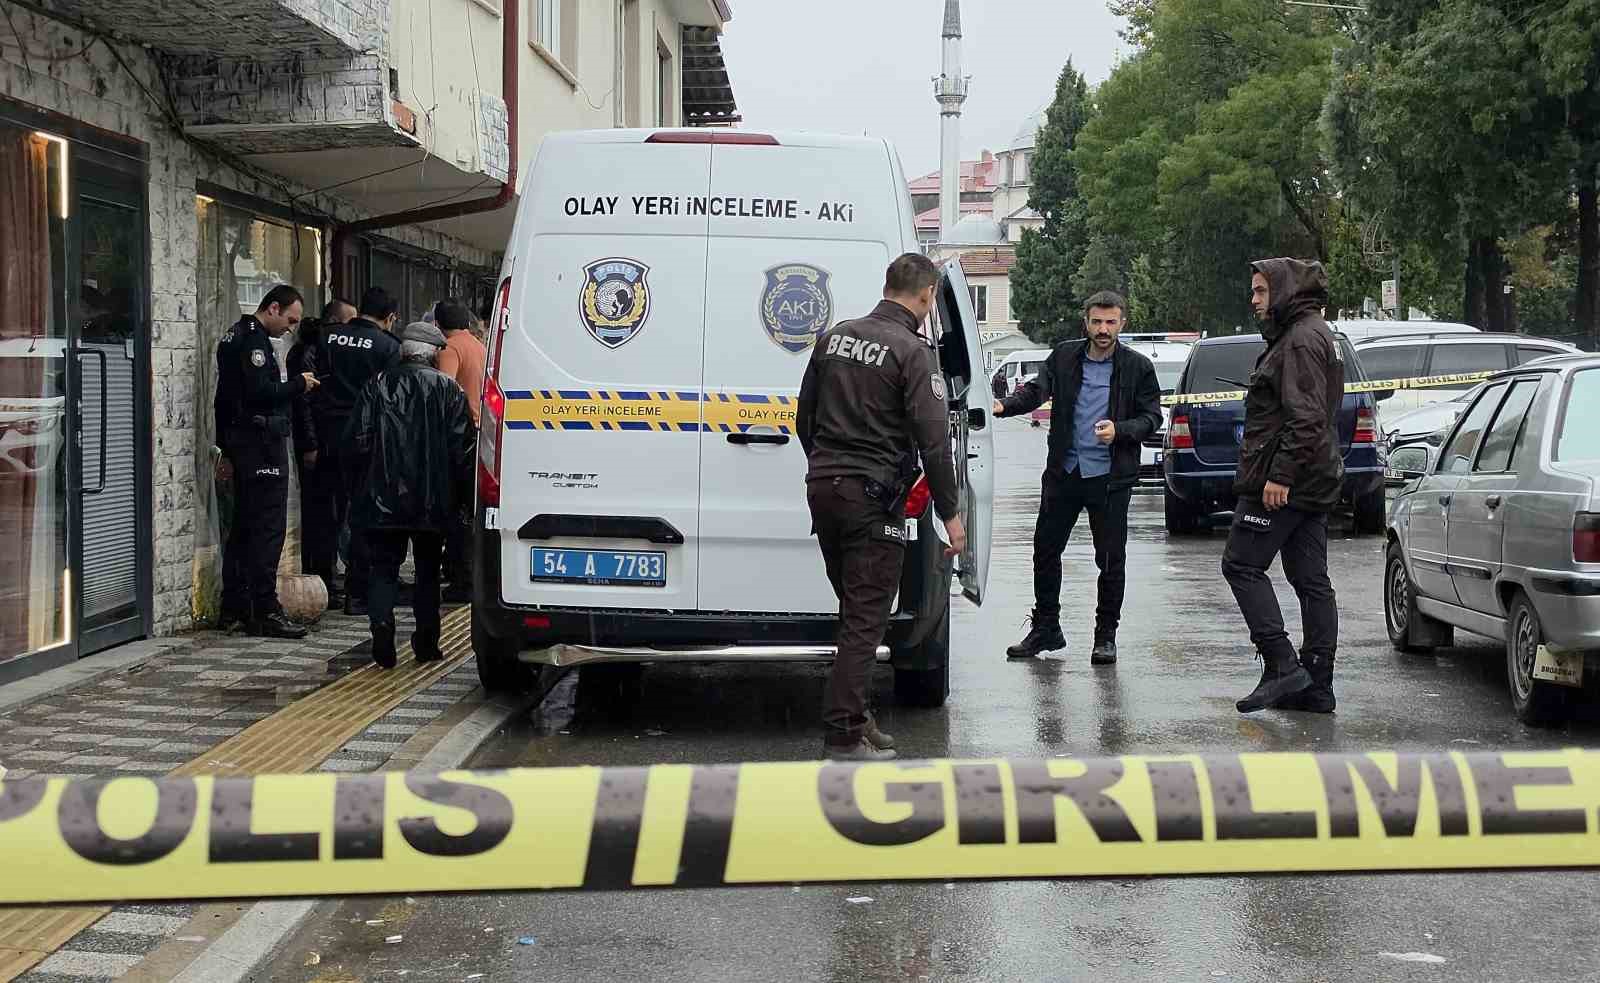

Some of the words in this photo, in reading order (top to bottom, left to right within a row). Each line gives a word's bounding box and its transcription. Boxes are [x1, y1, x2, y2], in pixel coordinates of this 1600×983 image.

[564, 196, 619, 217] OLAY
[542, 405, 571, 416] OLAY
[738, 408, 769, 419] OLAY
[772, 410, 797, 421] YER
[544, 552, 567, 575] 54
[584, 553, 596, 576] A
[613, 554, 661, 578] 7783
[816, 754, 1600, 847] GIRILME
